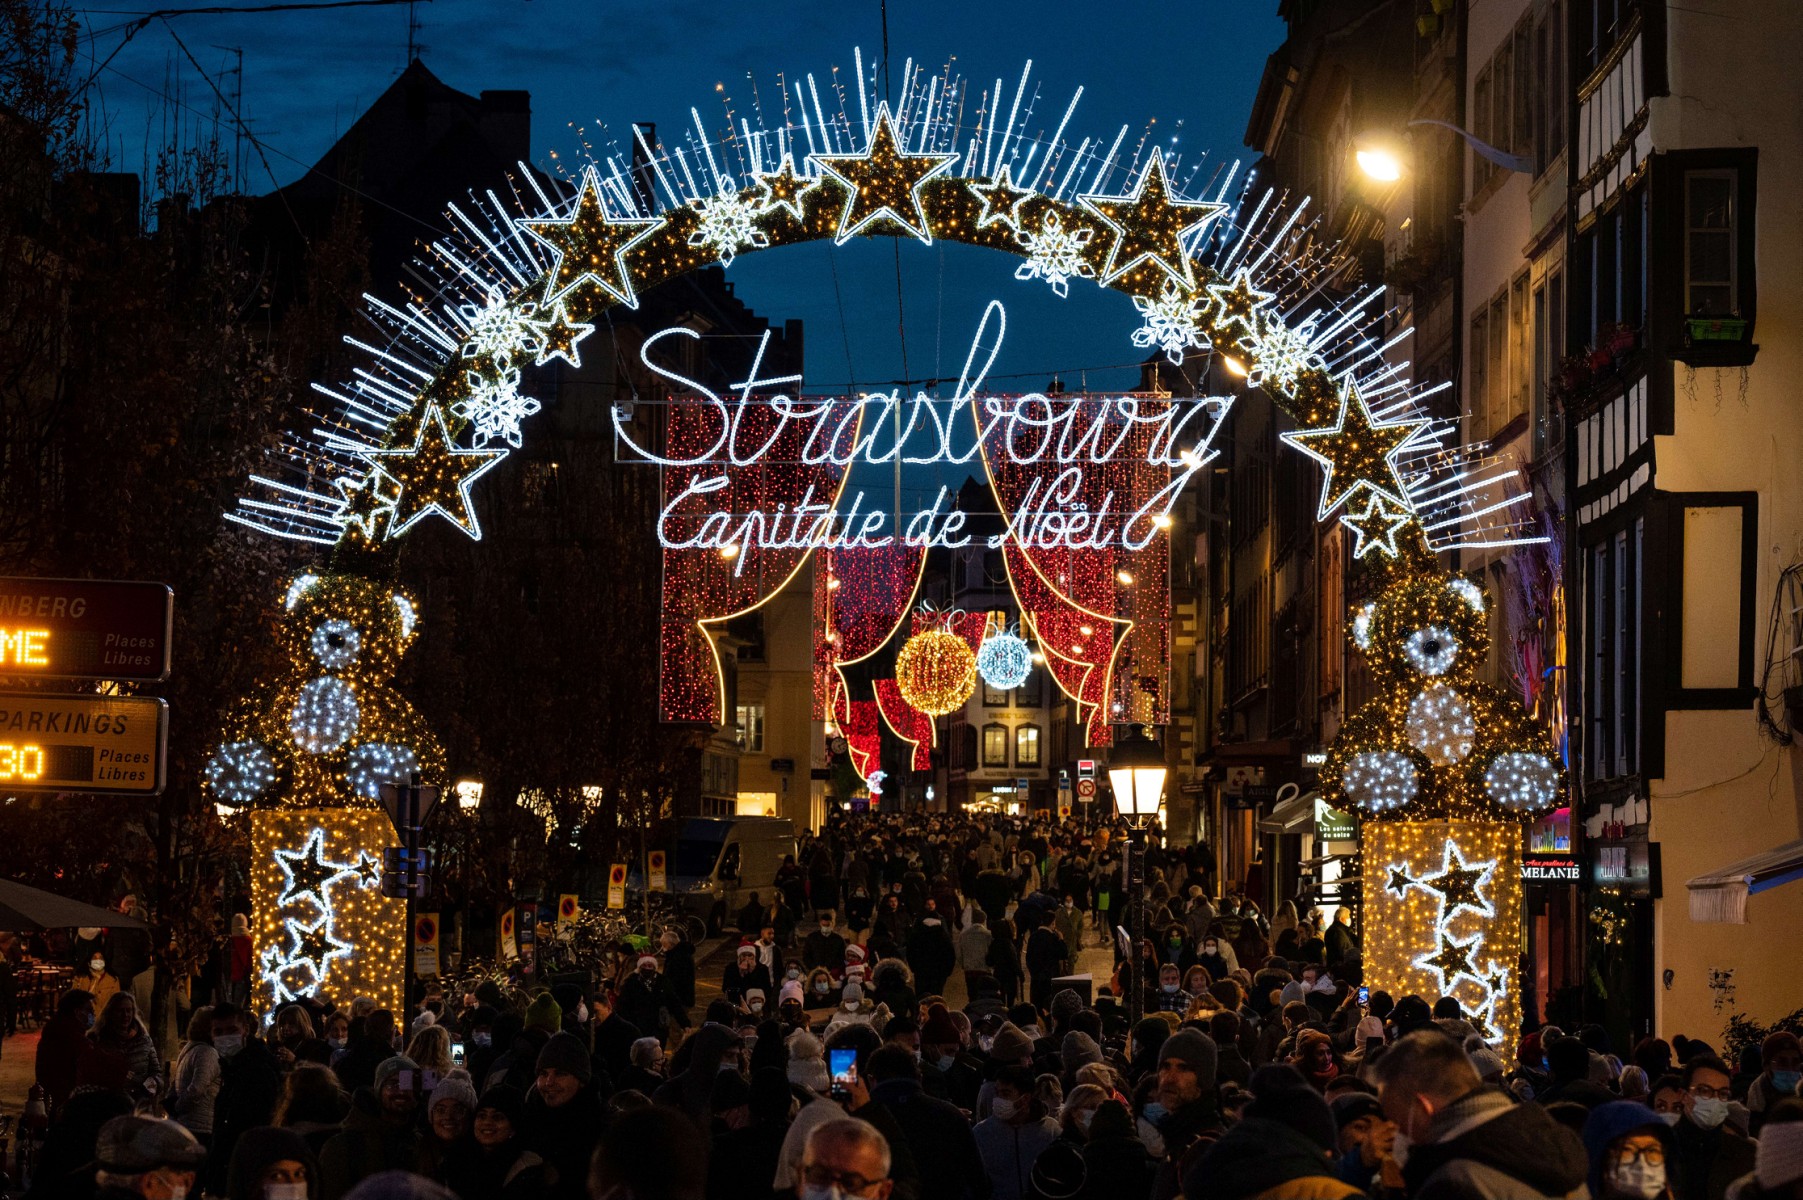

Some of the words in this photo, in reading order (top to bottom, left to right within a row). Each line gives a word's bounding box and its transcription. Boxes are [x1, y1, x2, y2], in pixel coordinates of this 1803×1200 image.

[611, 300, 1236, 550] Strasbourg
[657, 474, 894, 577] Capitale
[905, 485, 972, 548] de
[988, 467, 1114, 549] Noël
[0, 628, 50, 665] ME
[105, 633, 156, 648] Places
[104, 650, 152, 666] Libres
[99, 749, 150, 764] Places
[98, 766, 146, 781] Libres
